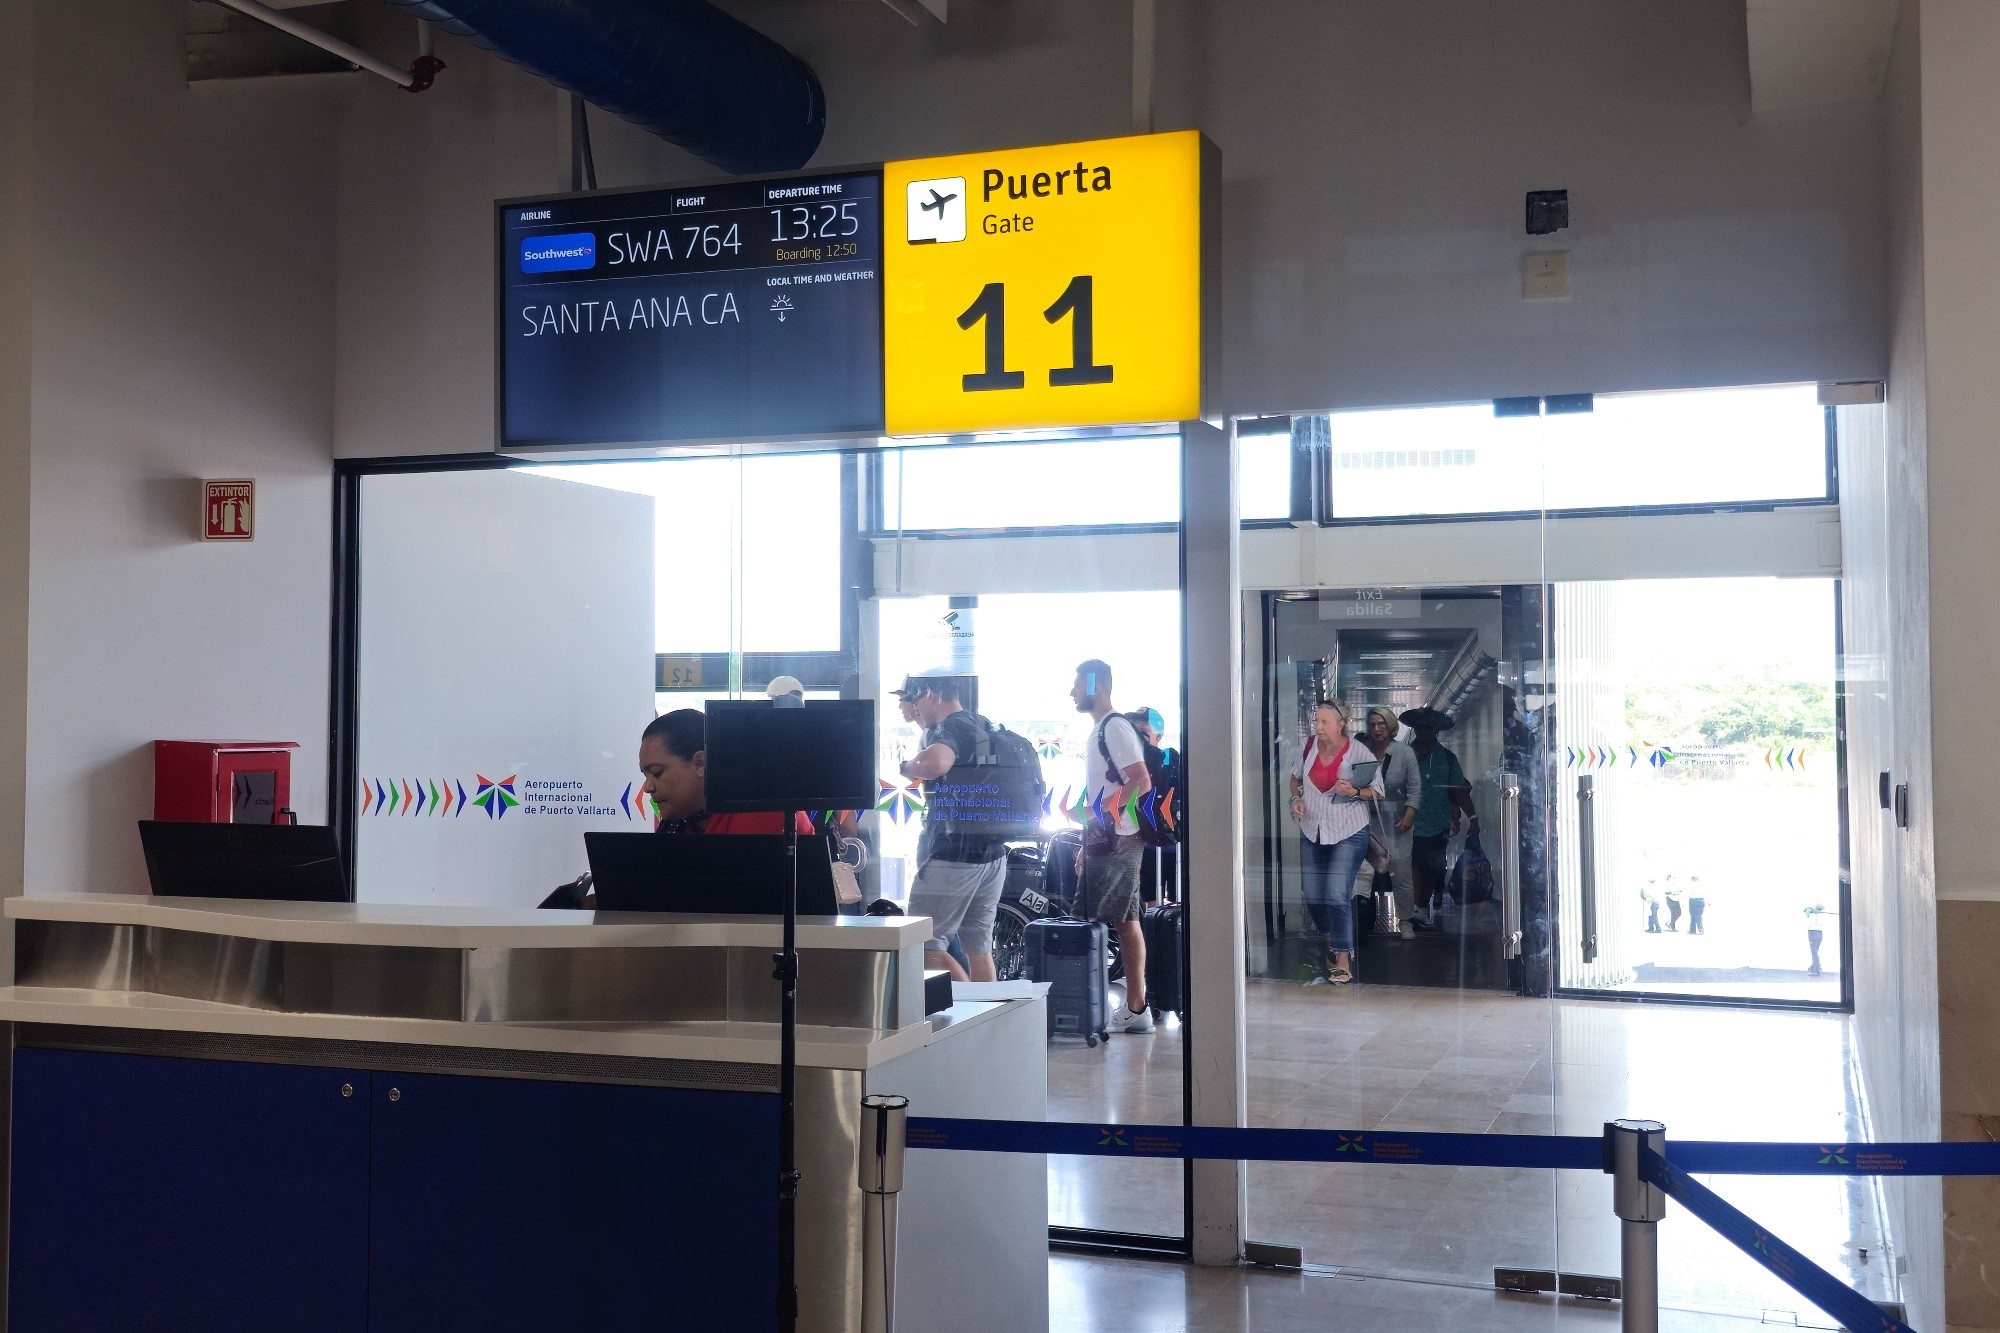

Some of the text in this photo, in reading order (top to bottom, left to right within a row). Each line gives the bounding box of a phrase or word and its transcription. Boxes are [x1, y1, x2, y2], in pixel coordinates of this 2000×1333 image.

[983, 161, 1112, 203] Puerta
[768, 184, 842, 199] DEPARTURE TIME
[676, 197, 705, 208] FLIGHT
[520, 210, 551, 221] AIRLINE
[770, 203, 859, 242] 13:25
[983, 213, 1034, 236] Gate
[608, 223, 742, 265] SWA 764
[524, 247, 584, 261] Southwest
[776, 243, 857, 262] Boarding 12:50
[767, 271, 874, 287] LOCAL TIME AND WEATHER
[522, 292, 740, 337] SANTA ANA CA
[956, 275, 1114, 392] 11
[209, 486, 249, 497] EXTINTOR
[525, 779, 583, 791] Aeropuerto
[933, 782, 1000, 794] Aeropuerto
[525, 792, 592, 803] Internacional
[524, 805, 616, 816] de Puerto Vallarta
[951, 810, 990, 821] Puerto
